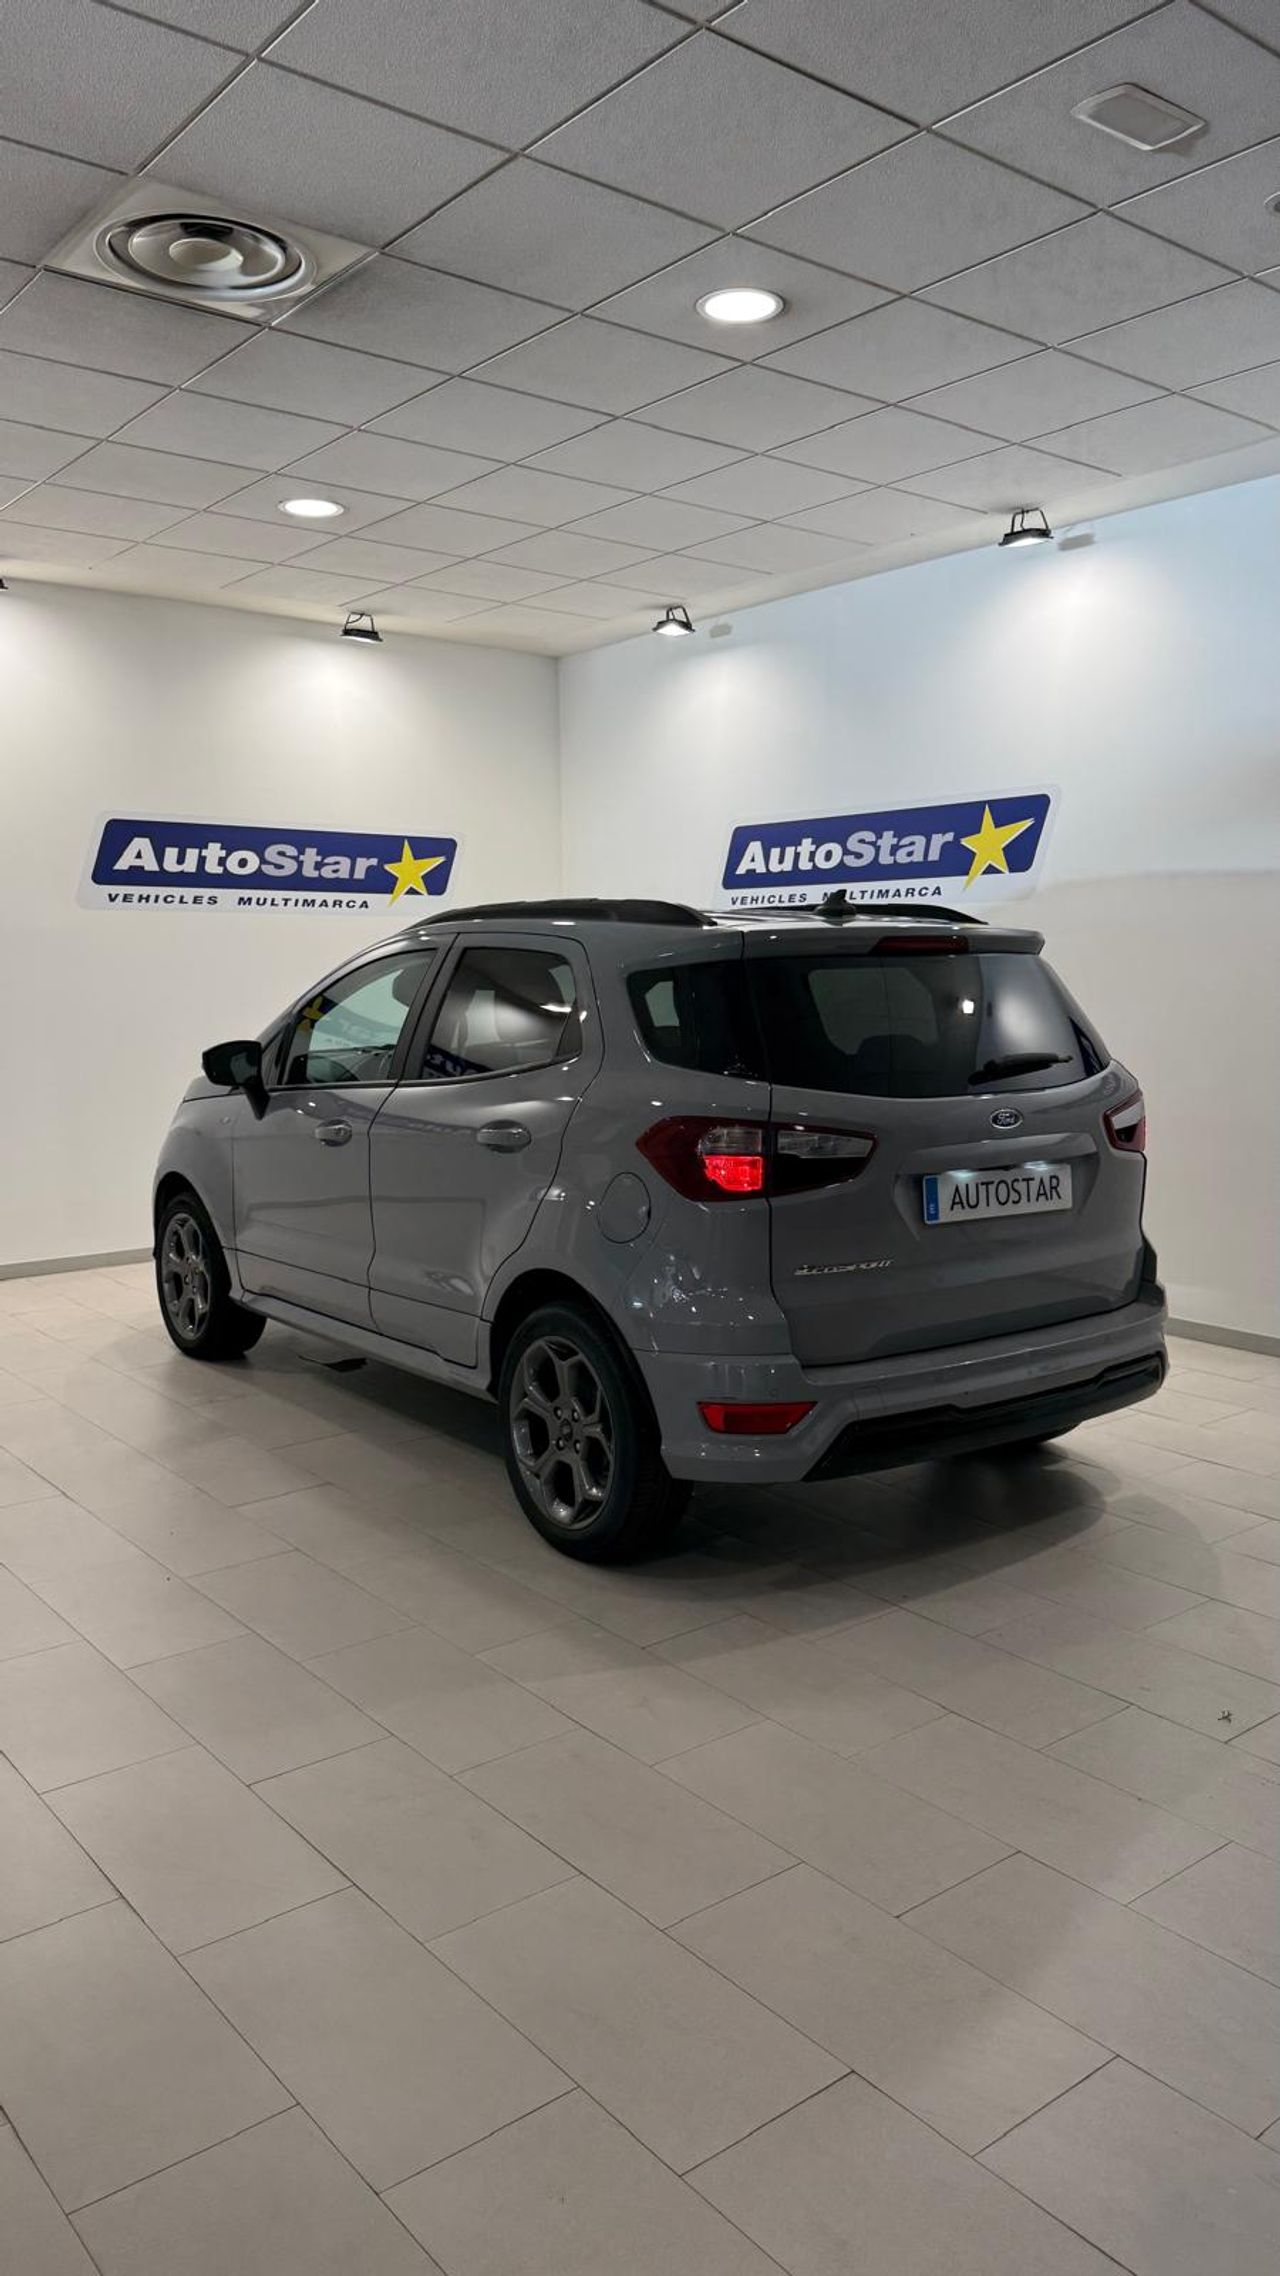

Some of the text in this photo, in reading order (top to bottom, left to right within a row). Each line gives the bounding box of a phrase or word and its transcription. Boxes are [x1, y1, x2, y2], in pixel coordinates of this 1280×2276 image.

[113, 837, 378, 880] AutoStar
[735, 831, 954, 875] AutoStar
[107, 893, 369, 909] VEHICLES MULTIMARCA
[731, 886, 942, 906] VEHICLES MLTIMARCA
[950, 1175, 1062, 1211] AUTOSTAR
